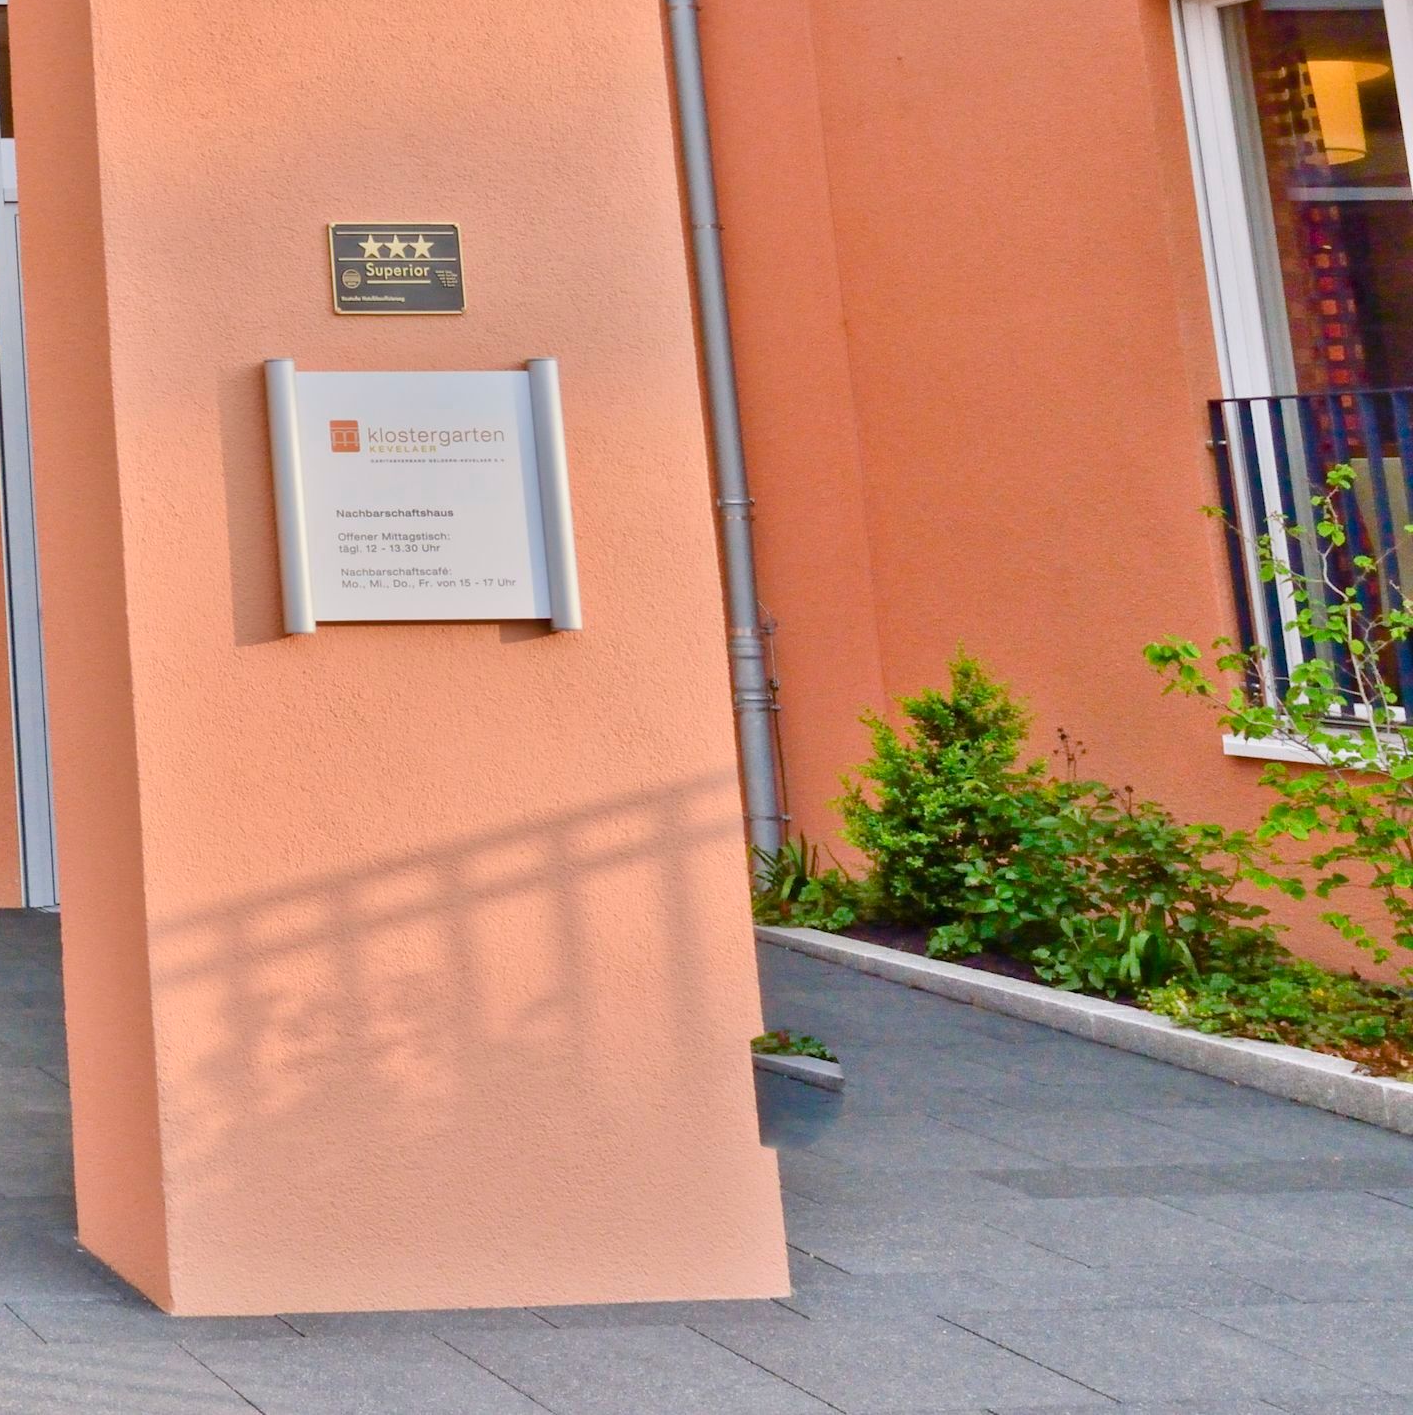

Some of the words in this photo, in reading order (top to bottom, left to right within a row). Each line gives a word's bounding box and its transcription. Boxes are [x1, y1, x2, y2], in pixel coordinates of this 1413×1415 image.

[366, 262, 430, 280] Superior
[367, 427, 505, 447] klostergarten
[369, 445, 438, 453] KEVELAER
[336, 509, 454, 518] Nachbarschaftshaus
[338, 532, 378, 542] Offener
[381, 532, 451, 542] Mittagstisch:
[366, 544, 377, 553] 12
[389, 544, 418, 553] 13.30
[421, 544, 441, 553] Uhr
[437, 580, 456, 588] von
[498, 578, 516, 587] Uhr
